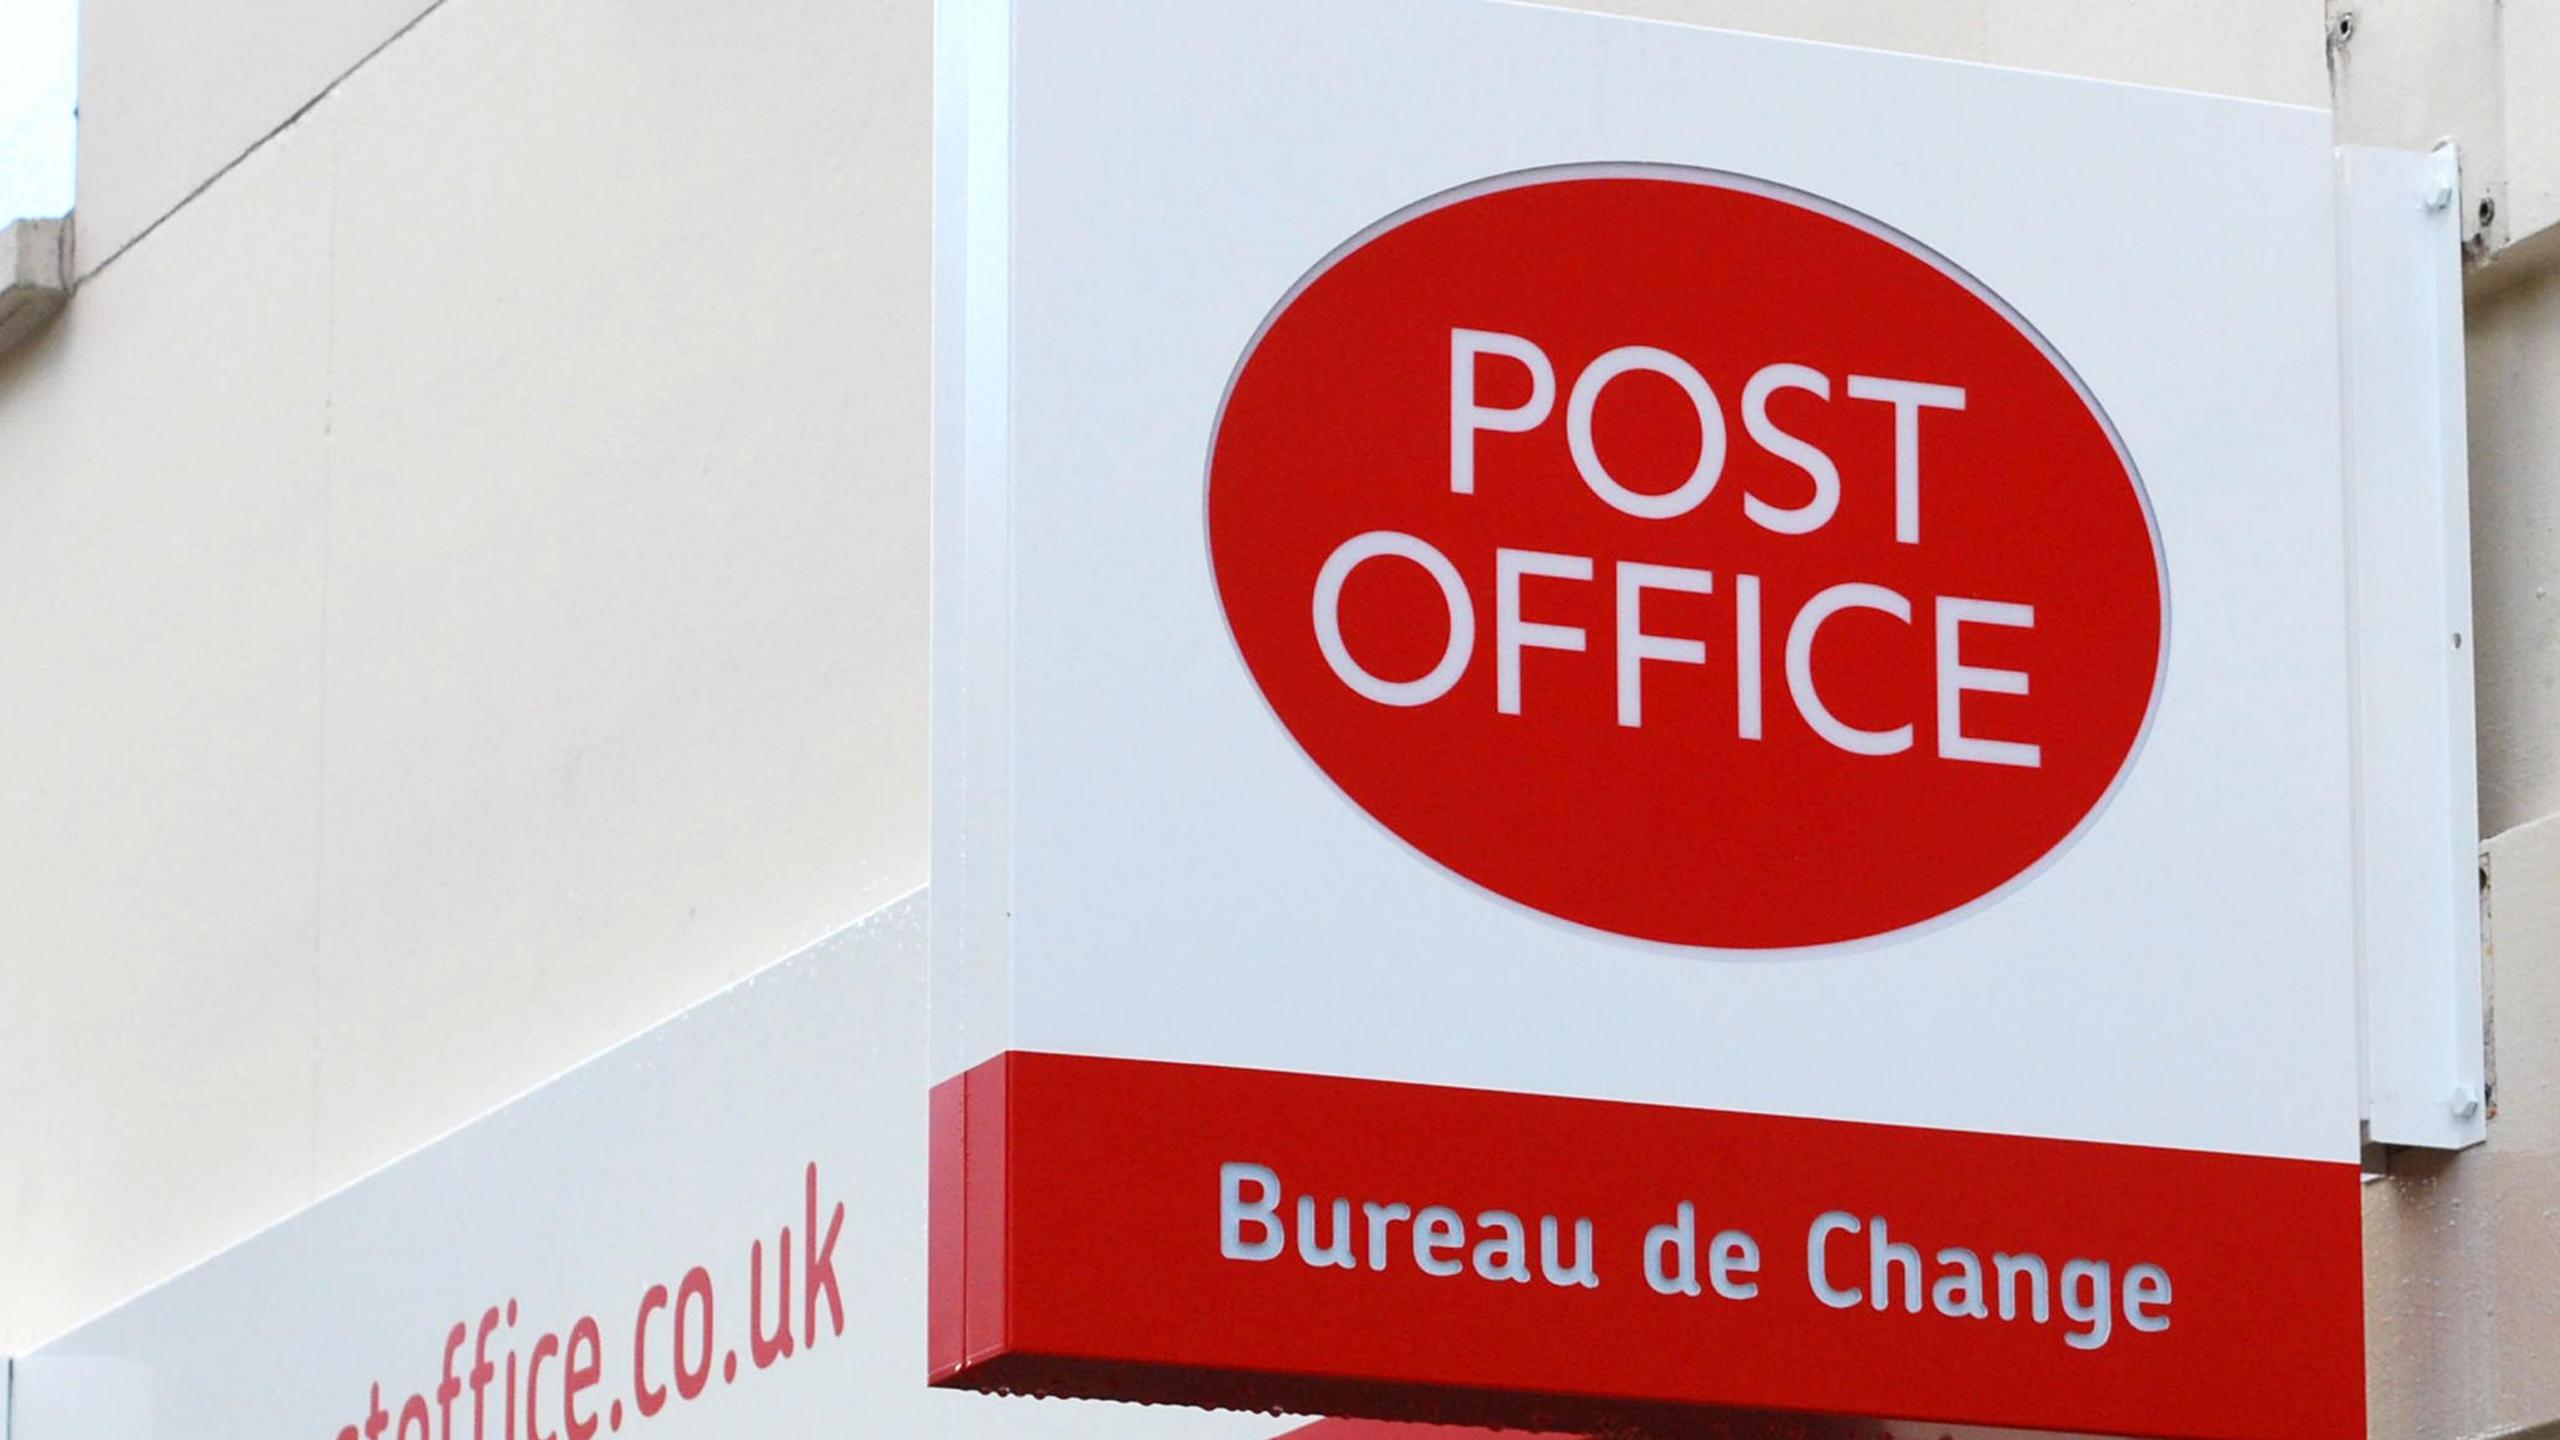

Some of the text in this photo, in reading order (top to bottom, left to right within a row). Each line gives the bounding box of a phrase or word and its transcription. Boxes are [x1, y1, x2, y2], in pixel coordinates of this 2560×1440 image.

[1449, 327, 1967, 546] POST
[1311, 530, 2042, 769] OFFICE
[336, 1162, 847, 1440] ffice.co.uk
[1219, 1161, 2173, 1351] Bureau de Change
